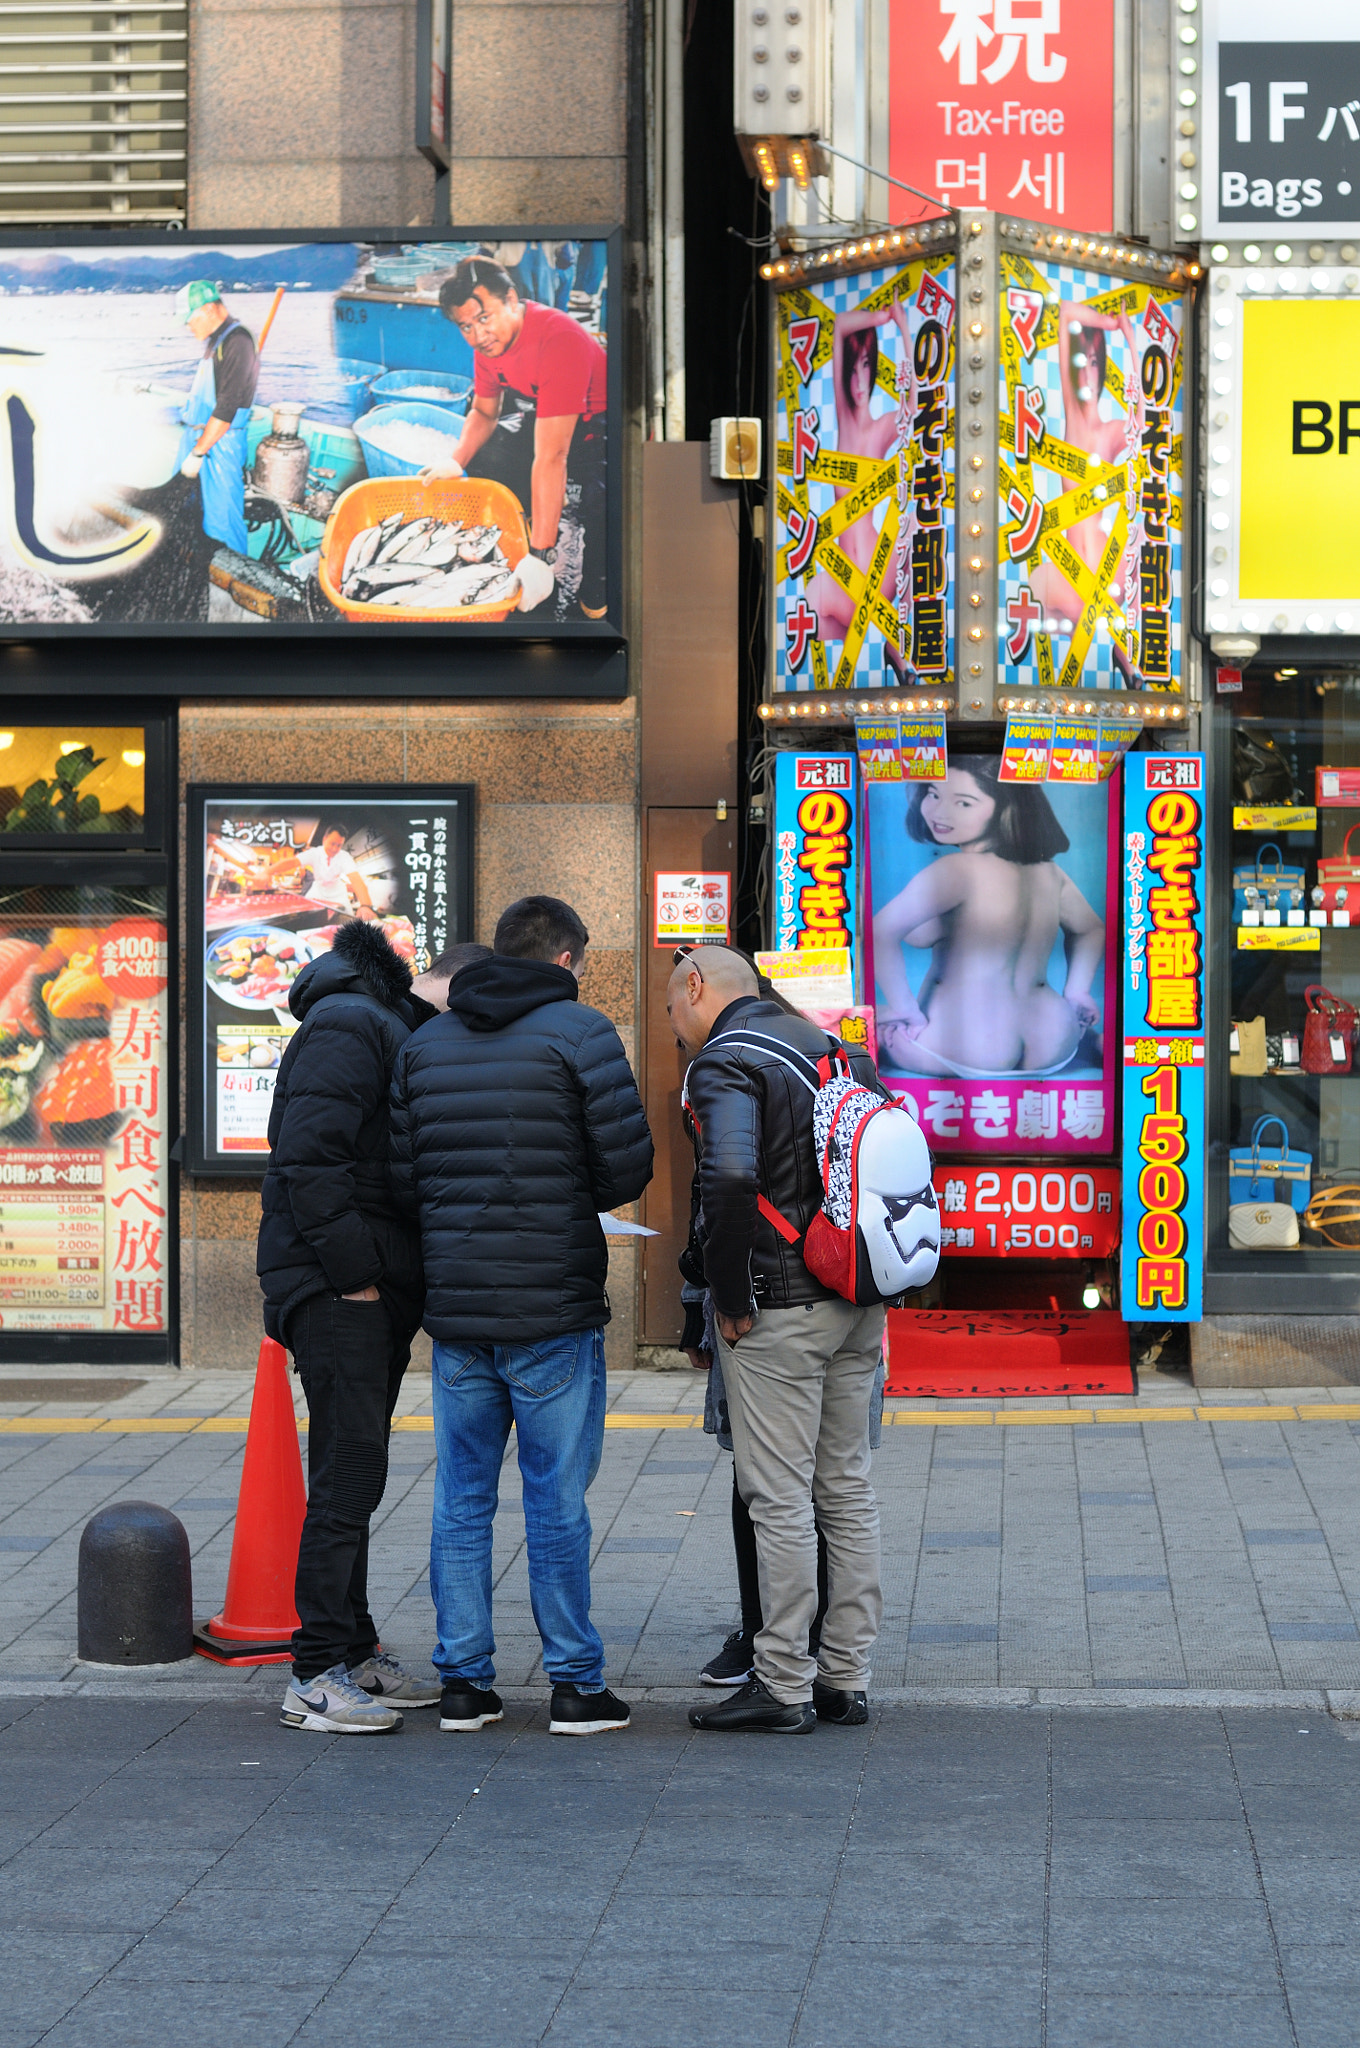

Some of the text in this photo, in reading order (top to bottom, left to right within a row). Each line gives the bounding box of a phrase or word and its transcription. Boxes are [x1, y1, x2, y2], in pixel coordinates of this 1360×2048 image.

[936, 101, 1065, 137] Tax-Free
[1224, 81, 1309, 143] 1F
[1221, 171, 1323, 218] Bags
[787, 316, 820, 676] マドンナ
[912, 318, 951, 676] のぞき部屋
[1006, 286, 1046, 667] マドンナ
[1139, 344, 1176, 683] のぞき部屋
[801, 763, 848, 787] 元祖
[1149, 763, 1199, 787] 元祖
[432, 816, 447, 956] 腕の確かな職人が、心を
[1126, 831, 1147, 990] 素人ストリップショー
[1146, 789, 1203, 1031] のぞき部屋
[110, 1006, 167, 1332] 寿司食べ放題
[975, 1171, 1111, 1219] 2,000円
[986, 1223, 1093, 1251] 1,500円
[1136, 1065, 1187, 1309] 1500円
[886, 1381, 1110, 1393] いらっしゃいませ
